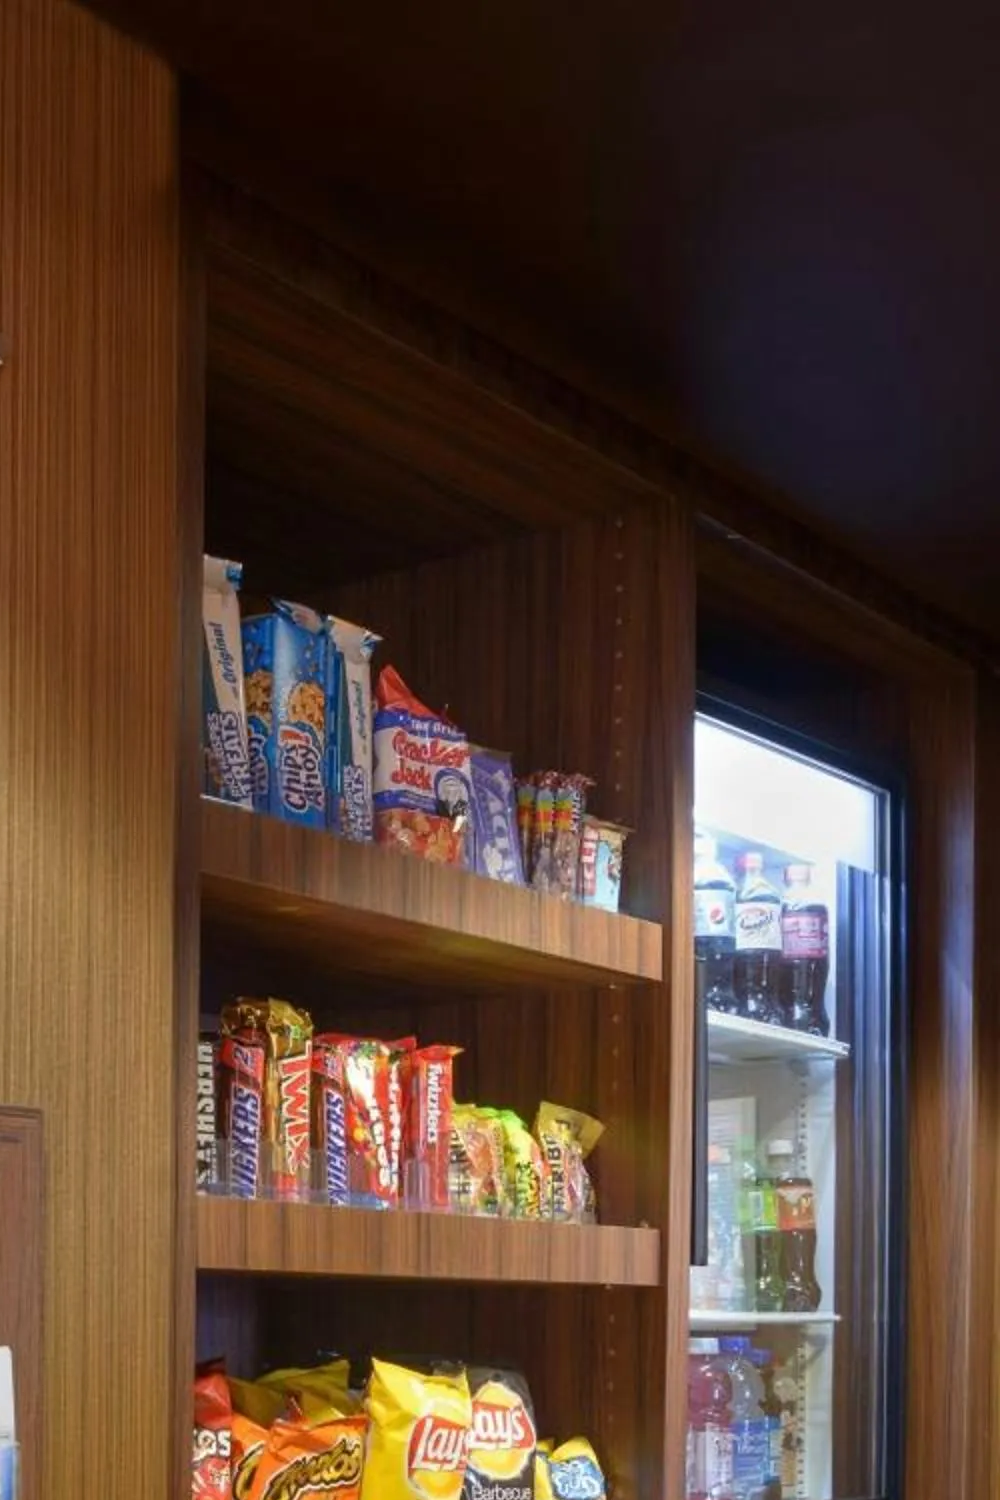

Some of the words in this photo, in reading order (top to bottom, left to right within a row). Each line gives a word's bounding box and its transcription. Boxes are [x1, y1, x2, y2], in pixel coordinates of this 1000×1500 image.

[209, 622, 237, 683] Original
[391, 758, 433, 792] Jack
[392, 728, 472, 769] Cracker
[283, 745, 304, 813] Chips
[427, 1062, 443, 1144] Twizzlers
[231, 1087, 260, 1199] NICKERS
[411, 1417, 466, 1471] Lay
[472, 1483, 532, 1500] Barbecue
